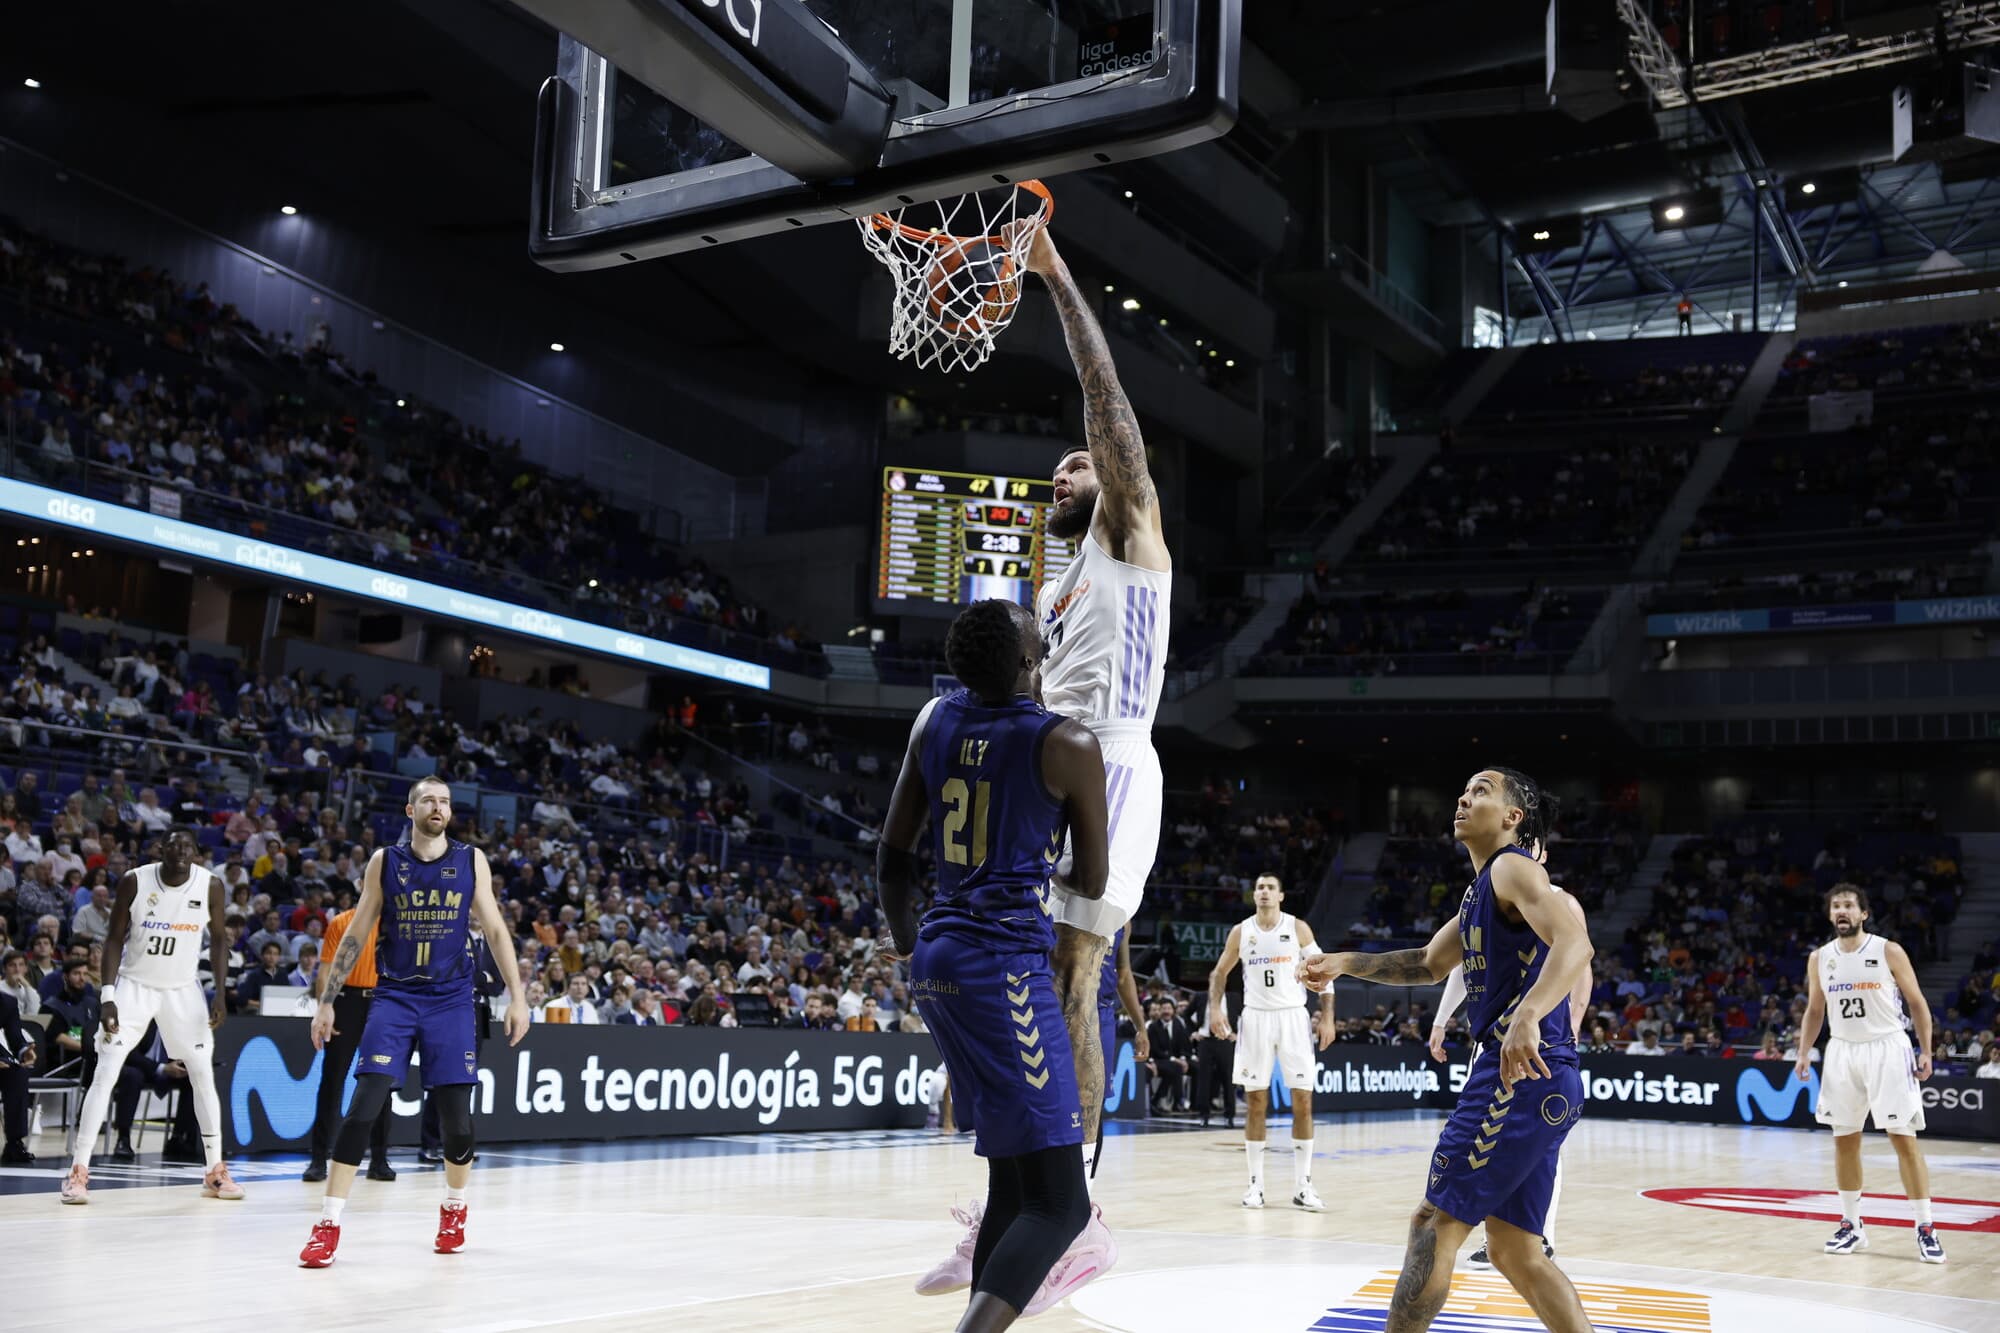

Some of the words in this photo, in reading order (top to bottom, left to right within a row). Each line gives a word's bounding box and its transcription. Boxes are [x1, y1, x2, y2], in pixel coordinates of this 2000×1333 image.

[1081, 41, 1115, 60] liga
[1080, 49, 1153, 77] endesa
[969, 479, 990, 493] 47
[47, 498, 96, 525] alsa
[982, 533, 1020, 553] 2:38
[978, 561, 986, 573] 1
[1006, 563, 1018, 576] 3
[371, 577, 408, 599] alsa
[960, 738, 989, 766] ILY
[941, 777, 991, 867] 21
[394, 889, 462, 909] UCAM
[396, 910, 459, 920] UNIVERSIDAD
[140, 920, 200, 932] AUTOHERO
[147, 936, 176, 956] 30
[1190, 944, 1222, 960] EXI
[1248, 956, 1292, 966] AUTOHERO
[1264, 969, 1275, 987] 6
[1828, 982, 1882, 992] AUTOHERO
[1840, 998, 1866, 1018] 23
[515, 1050, 565, 1114] la
[580, 1050, 820, 1125] tecnología
[831, 1055, 884, 1107] 5G
[1314, 1061, 1343, 1094] Con
[1345, 1061, 1361, 1093] la
[1362, 1060, 1440, 1100] tecnología
